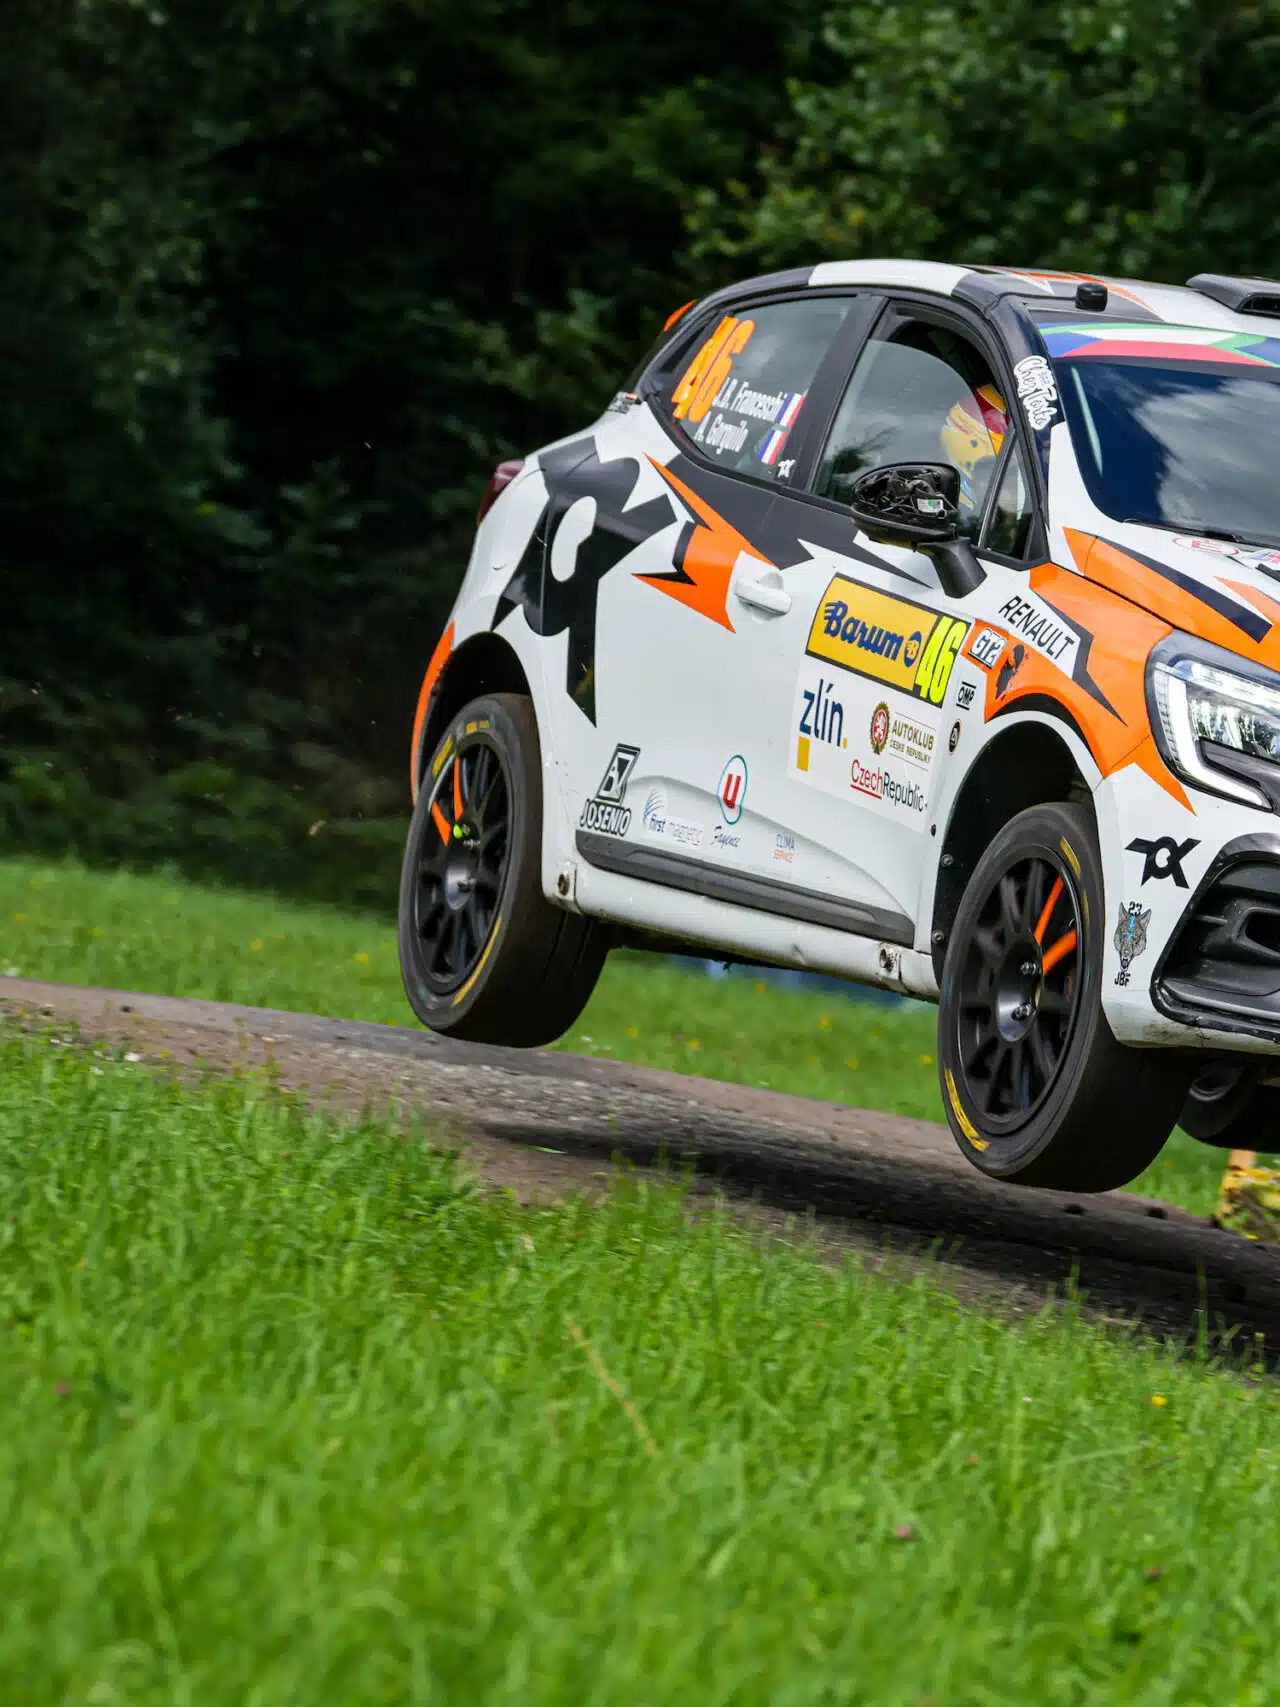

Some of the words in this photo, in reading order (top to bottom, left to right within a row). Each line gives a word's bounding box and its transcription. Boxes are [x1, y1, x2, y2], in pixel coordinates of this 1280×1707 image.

[672, 316, 756, 423] 46
[823, 601, 905, 662] Barum
[999, 596, 1076, 660] RENAULT
[915, 616, 968, 704] 46
[892, 719, 935, 751] AUTOKLUB
[579, 798, 632, 837] JOSENIO
